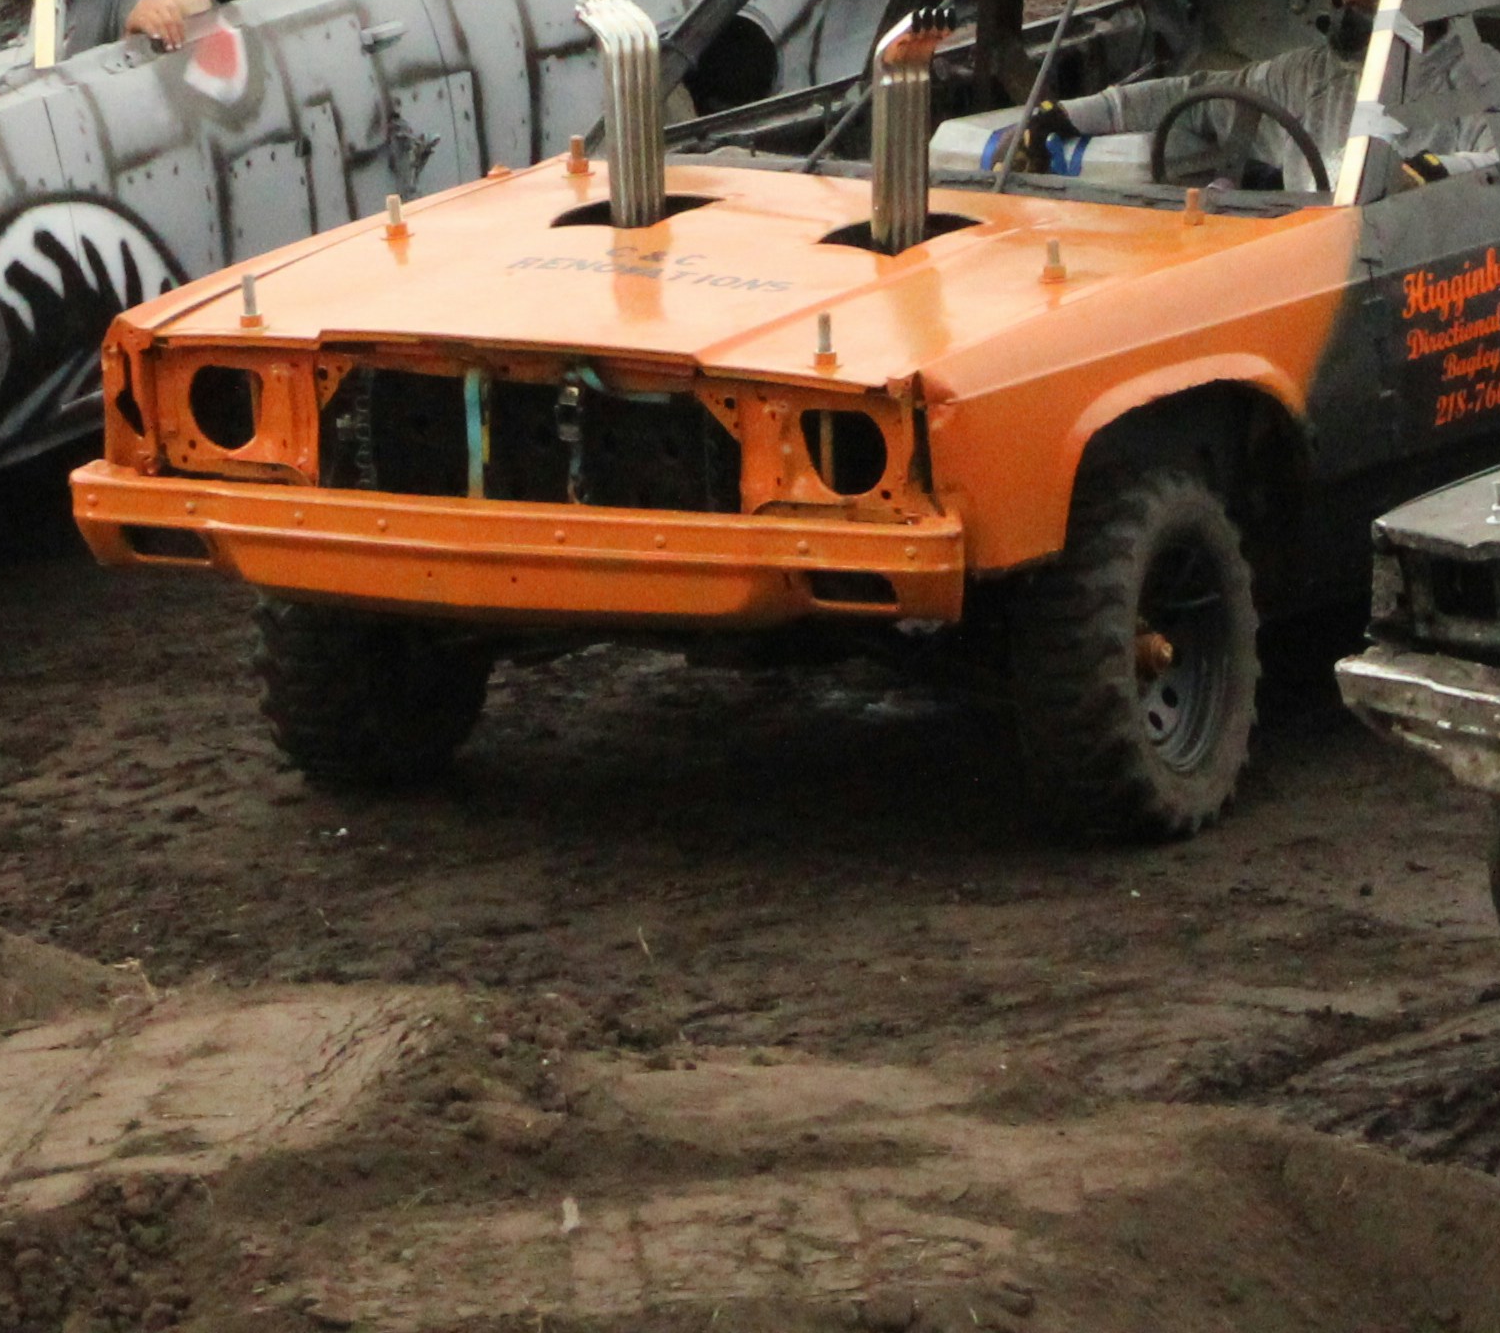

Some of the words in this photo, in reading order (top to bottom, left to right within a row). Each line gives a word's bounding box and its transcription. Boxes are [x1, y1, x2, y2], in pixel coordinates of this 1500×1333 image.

[605, 246, 639, 257] C
[675, 254, 708, 266] C
[506, 256, 795, 292] RENOVATIONS
